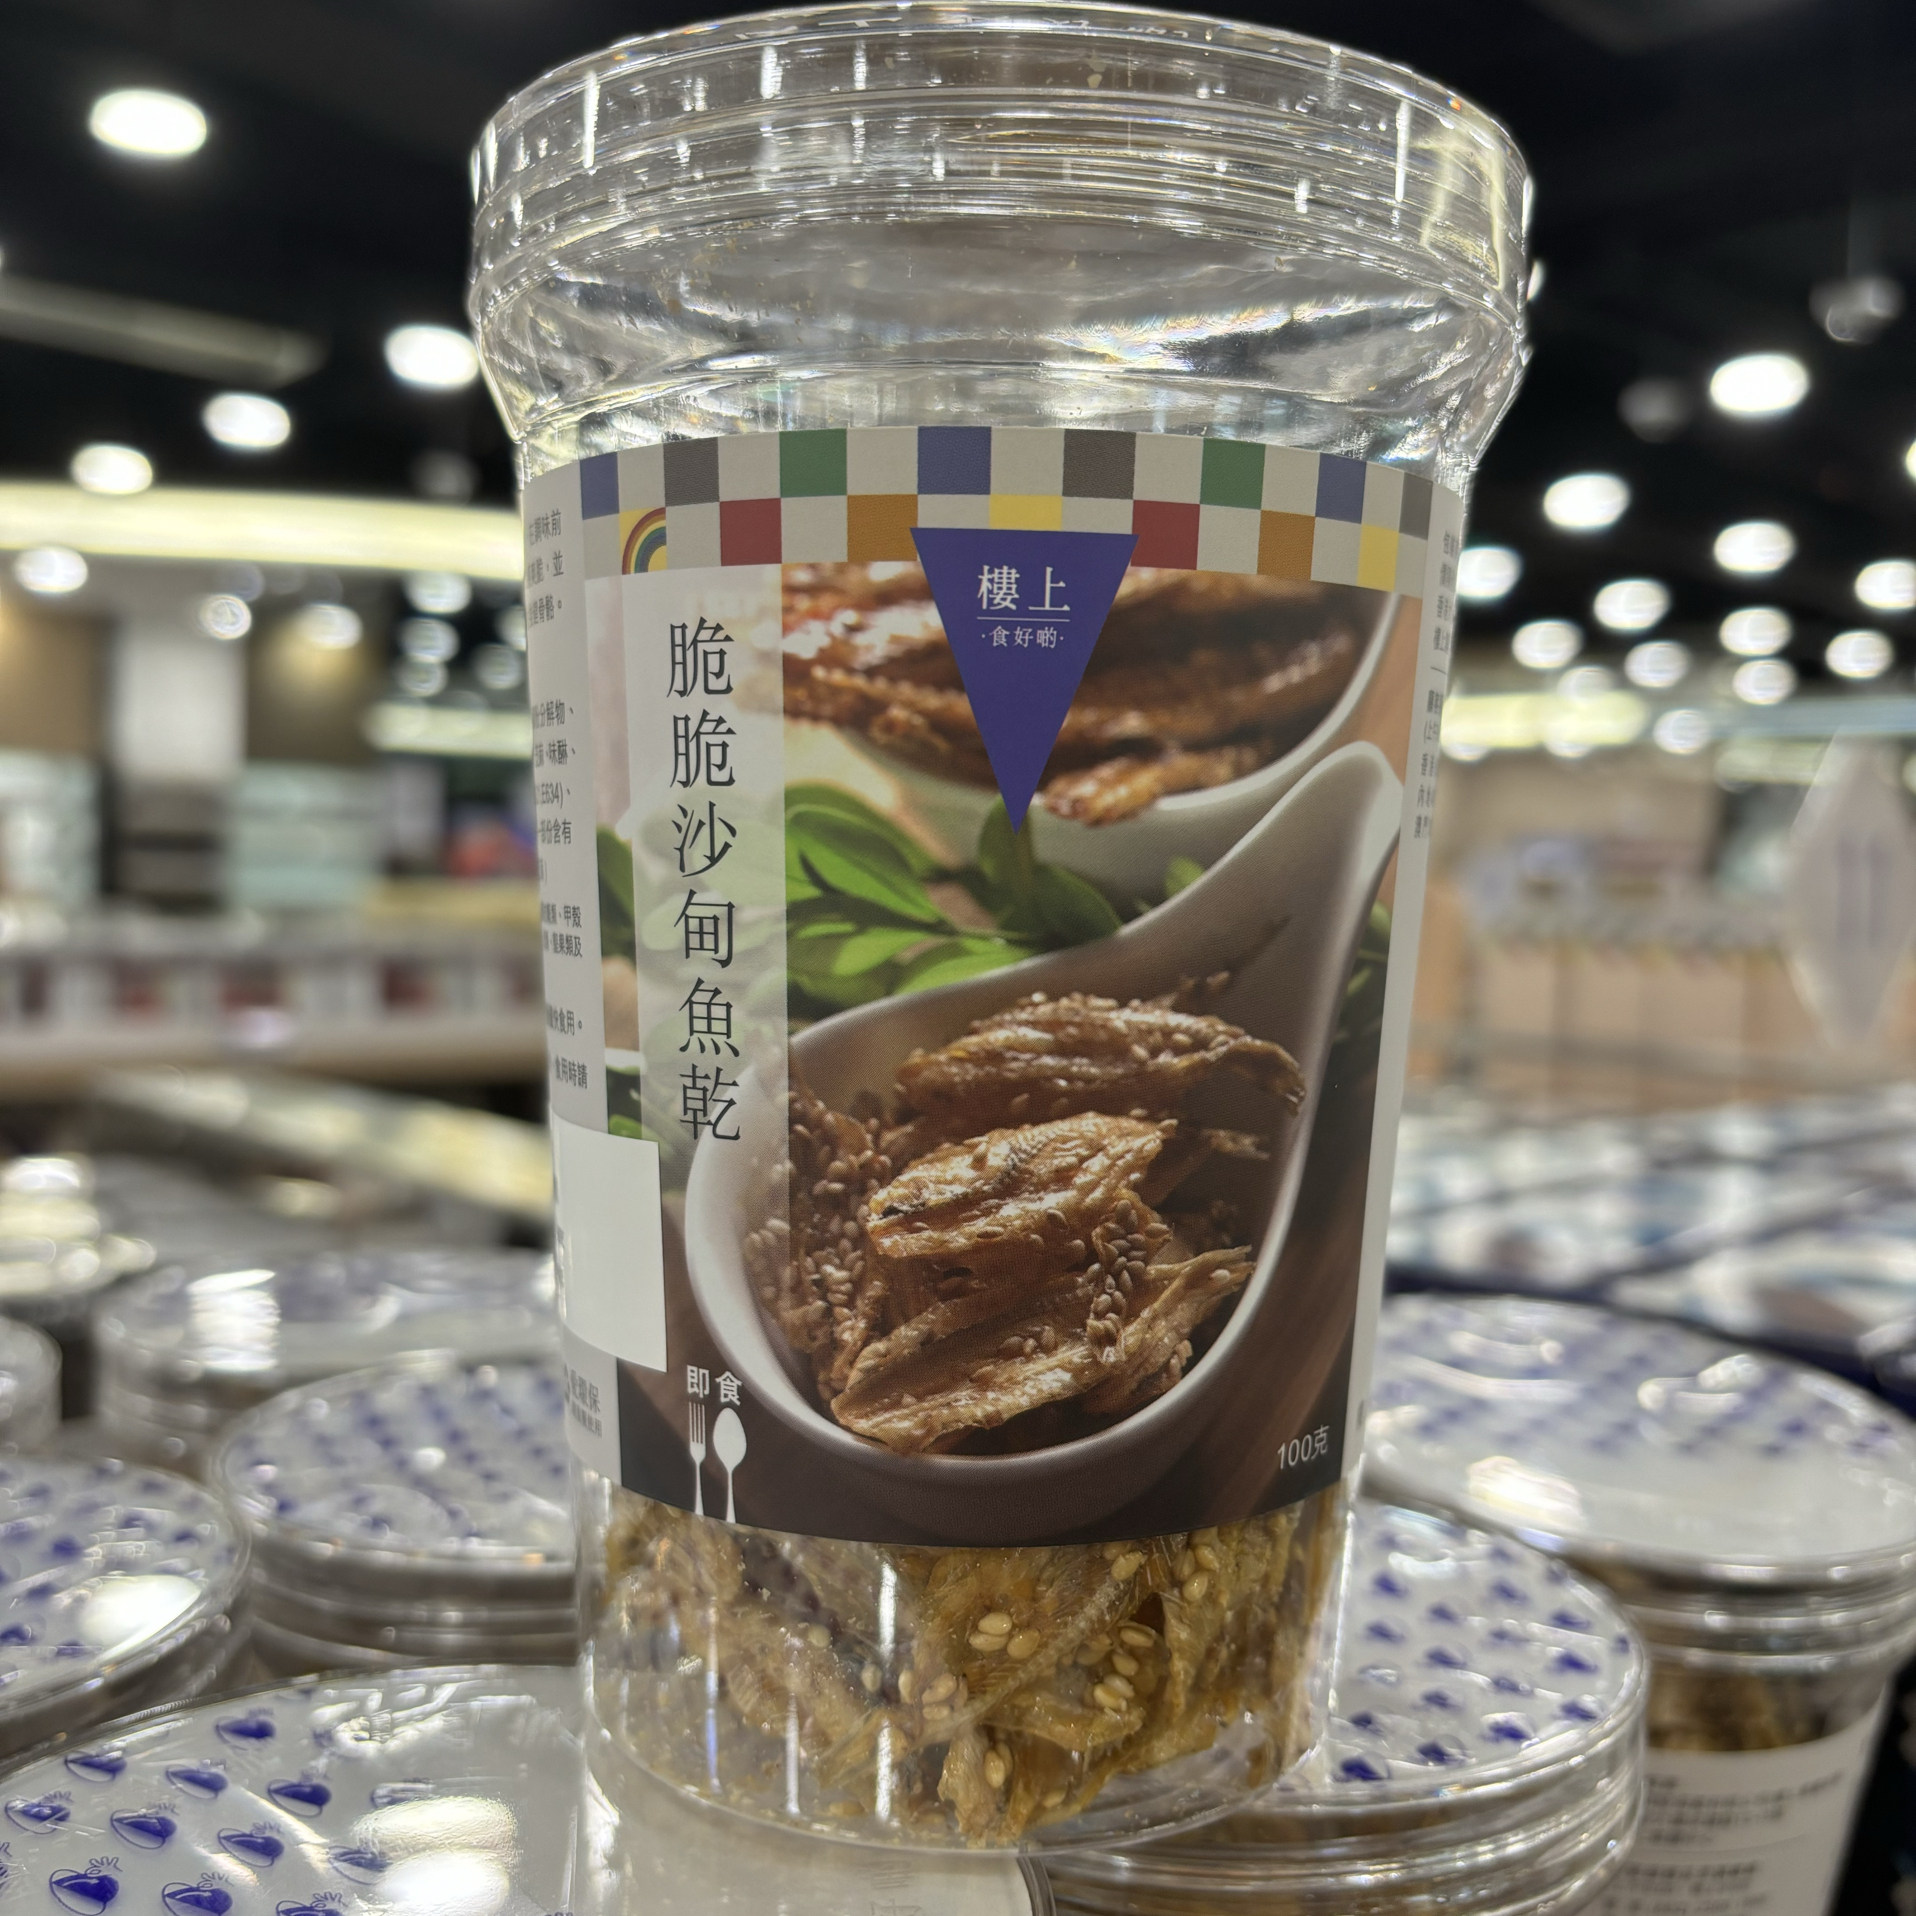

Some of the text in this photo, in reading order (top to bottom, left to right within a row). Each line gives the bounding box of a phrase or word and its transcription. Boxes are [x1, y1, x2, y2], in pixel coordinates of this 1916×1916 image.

[977, 565, 1070, 611] 樓上
[666, 616, 741, 1141] 脆脆沙甸魚乾
[686, 1365, 743, 1406] 即食
[1277, 1424, 1331, 1470] 100克
